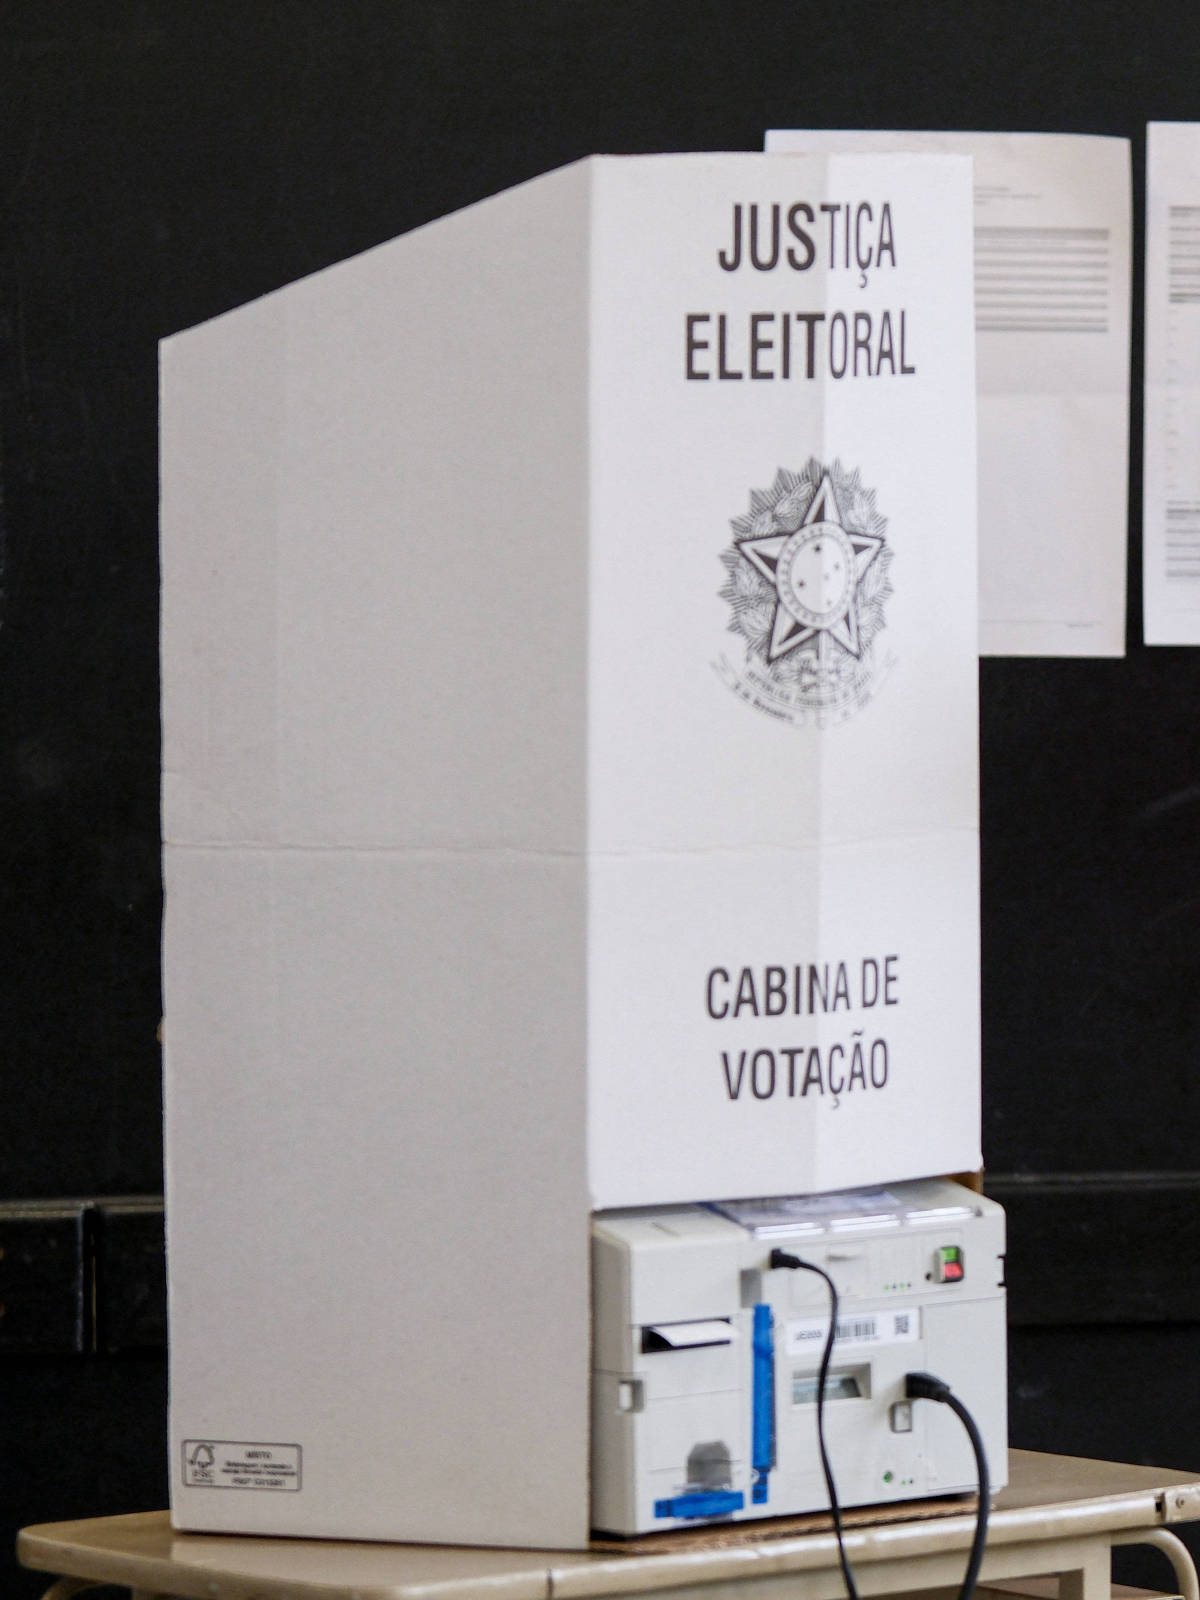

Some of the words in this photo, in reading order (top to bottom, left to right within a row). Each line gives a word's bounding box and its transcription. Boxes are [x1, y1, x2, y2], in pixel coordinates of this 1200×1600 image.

[717, 202, 896, 289] JUSTIÇA
[685, 310, 916, 380] ELEITORAL
[706, 961, 851, 1019] CABINA
[861, 955, 898, 1008] DE
[721, 1029, 888, 1110] VOTAÇÃO
